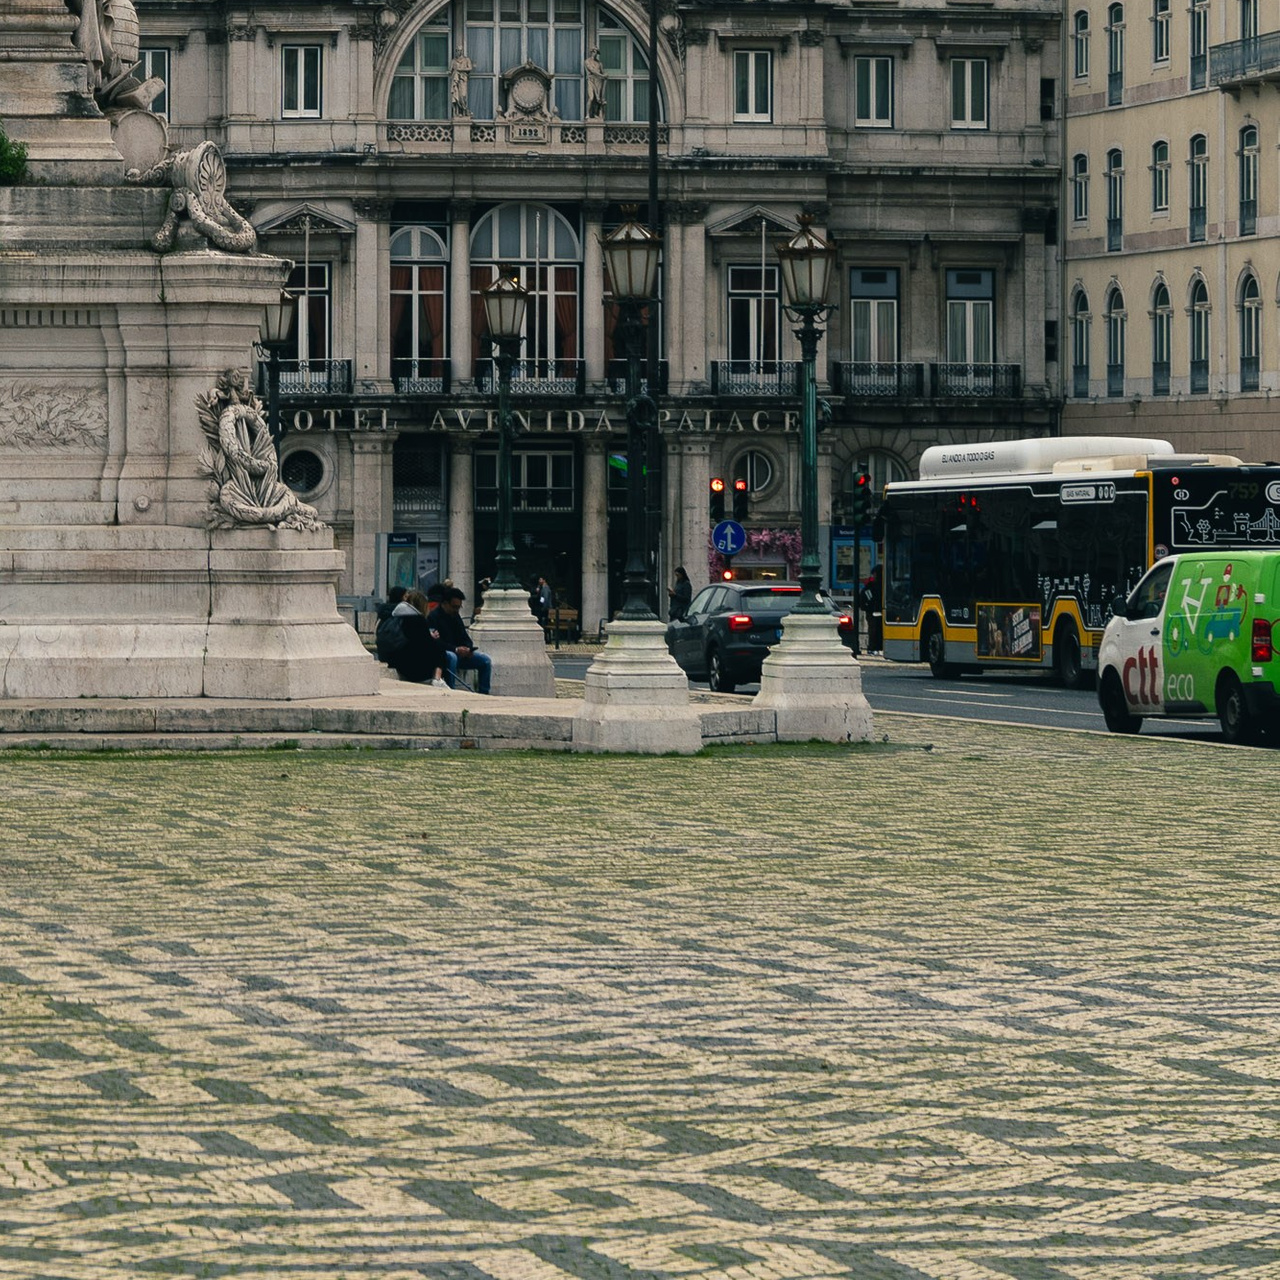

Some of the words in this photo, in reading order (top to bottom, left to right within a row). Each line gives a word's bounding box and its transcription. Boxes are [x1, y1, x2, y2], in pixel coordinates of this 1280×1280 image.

[519, 128, 539, 137] 1892
[658, 409, 800, 433] PALACE
[1228, 483, 1260, 499] 759
[1123, 645, 1160, 705] ctt
[1168, 674, 1194, 700] eco
